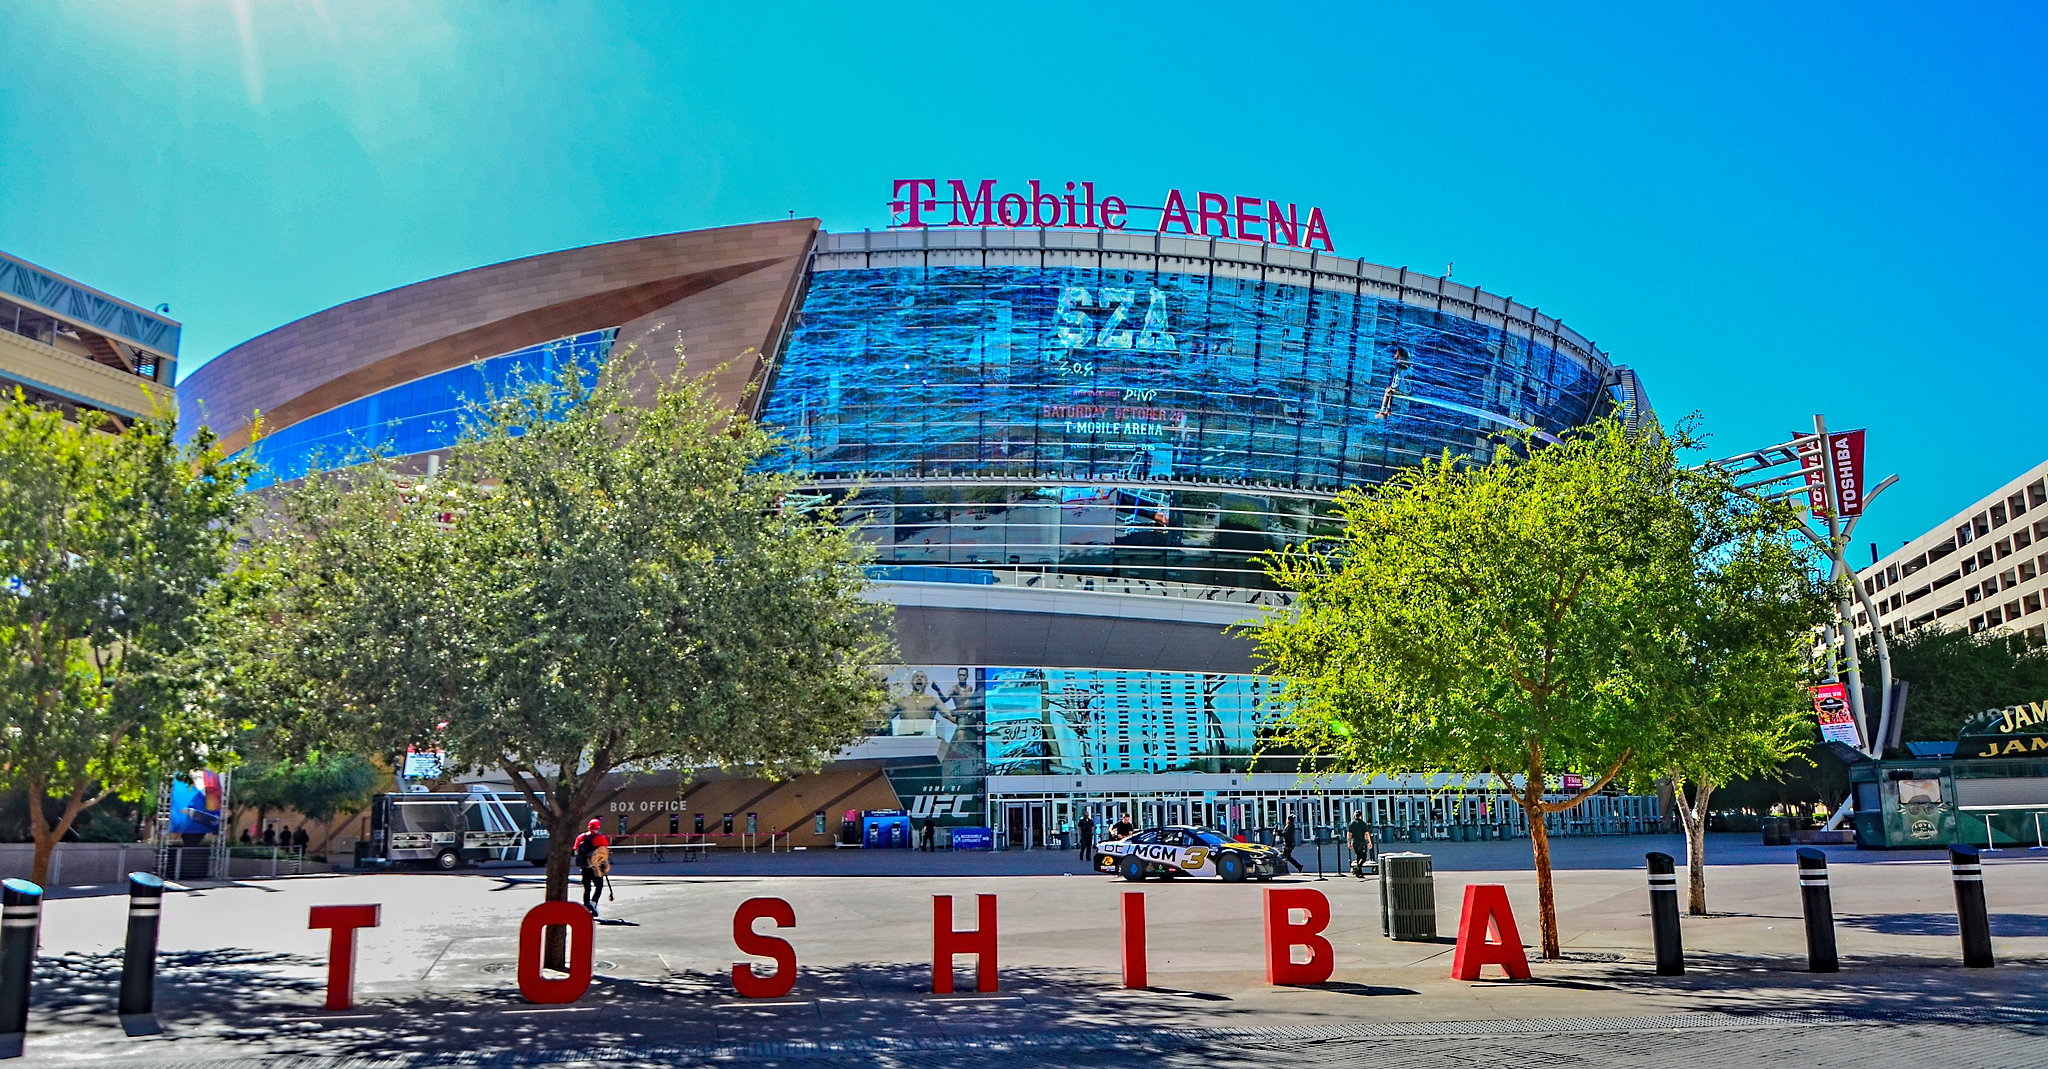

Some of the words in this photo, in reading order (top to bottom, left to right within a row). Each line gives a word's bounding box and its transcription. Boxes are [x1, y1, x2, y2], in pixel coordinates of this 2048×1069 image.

[1157, 189, 1335, 252] ARENA
[1057, 286, 1176, 350] SZA
[1043, 405, 1108, 419] SATURDAY
[1114, 406, 1166, 421] OCTOBER
[1064, 421, 1120, 434] T-MOBILE
[1123, 423, 1163, 436] ARENA
[1835, 437, 1857, 512] TOSHIBA
[610, 802, 635, 811] BOX
[640, 801, 687, 811] OFFICE
[911, 795, 973, 818] UFC
[1180, 845, 1209, 870] 3
